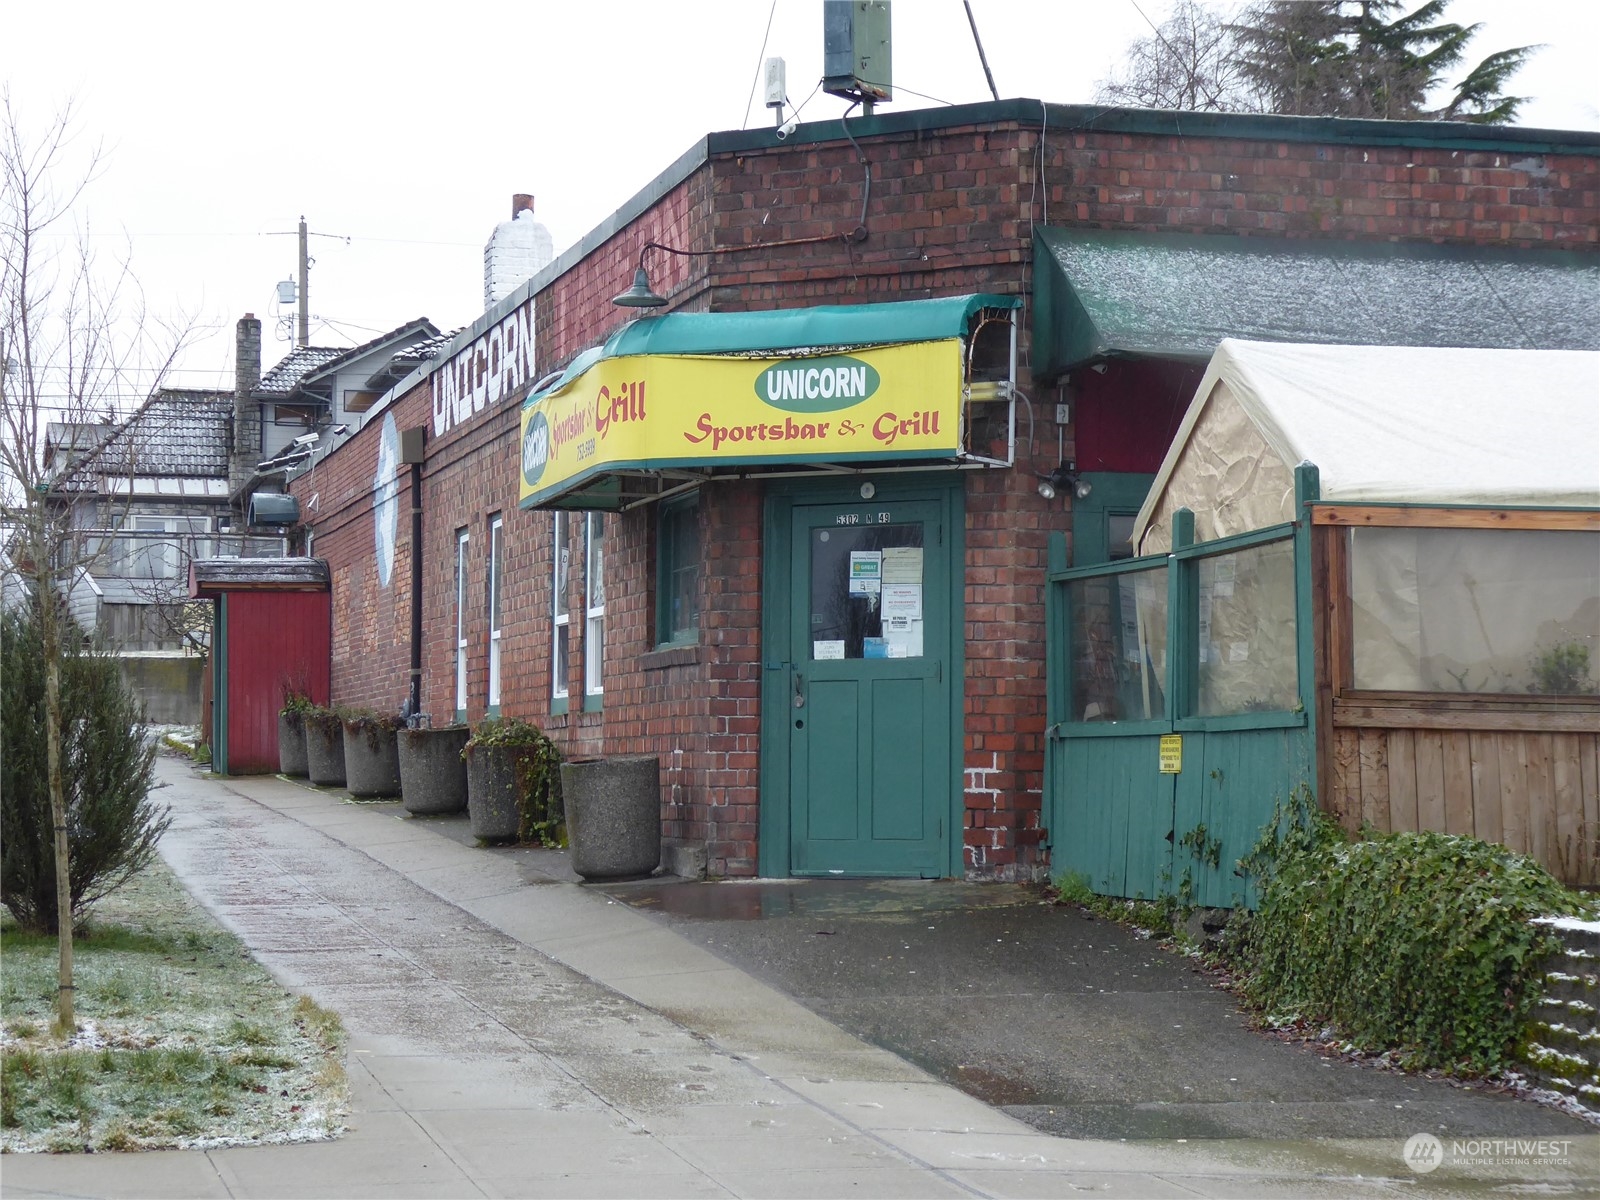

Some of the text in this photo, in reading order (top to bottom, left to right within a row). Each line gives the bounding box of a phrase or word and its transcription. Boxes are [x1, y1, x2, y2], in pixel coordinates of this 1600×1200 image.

[433, 297, 535, 437] UNICORN
[767, 366, 866, 401] UNICORN
[550, 401, 585, 460] Sportsbar
[595, 380, 646, 440] Grill
[683, 410, 940, 450] Sportsbar & Grill
[836, 513, 890, 524] 5302 N 49
